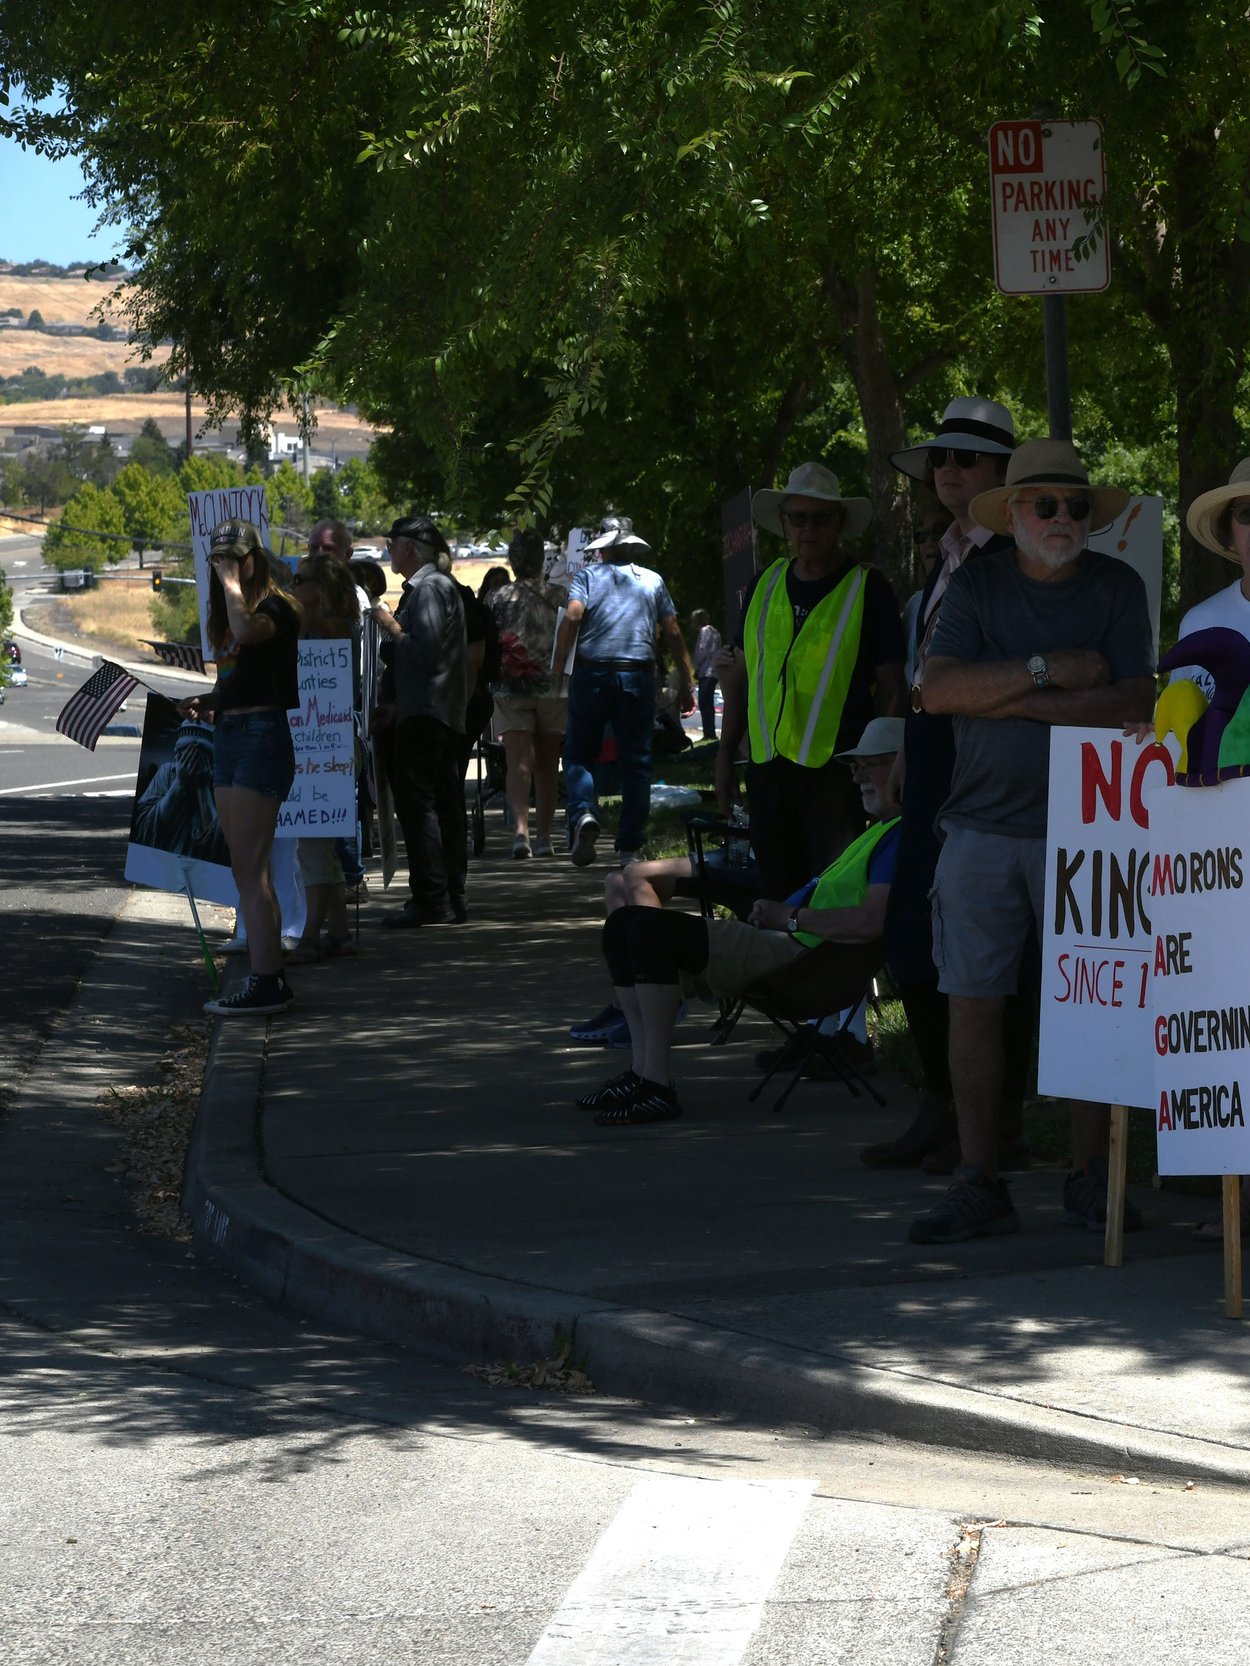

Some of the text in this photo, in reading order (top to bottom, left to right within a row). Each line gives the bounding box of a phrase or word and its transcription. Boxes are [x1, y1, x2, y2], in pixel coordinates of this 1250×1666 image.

[997, 129, 1035, 166] NO
[1001, 179, 1096, 213] PARKING
[1032, 218, 1070, 242] ANY
[1030, 249, 1075, 273] TIME
[338, 647, 348, 669] 5
[298, 673, 337, 690] unties
[305, 694, 353, 728] Medicaid
[294, 729, 342, 743] children
[306, 757, 320, 775] he
[312, 784, 329, 803] be
[1080, 739, 1176, 830] NO
[275, 808, 348, 828] HAMED!!!
[1151, 846, 1245, 898] MORONS
[1054, 847, 1153, 940] KIN
[1153, 931, 1193, 978] ARE
[1053, 953, 1126, 1009] SINCE
[1158, 1081, 1246, 1133] AMERICA
